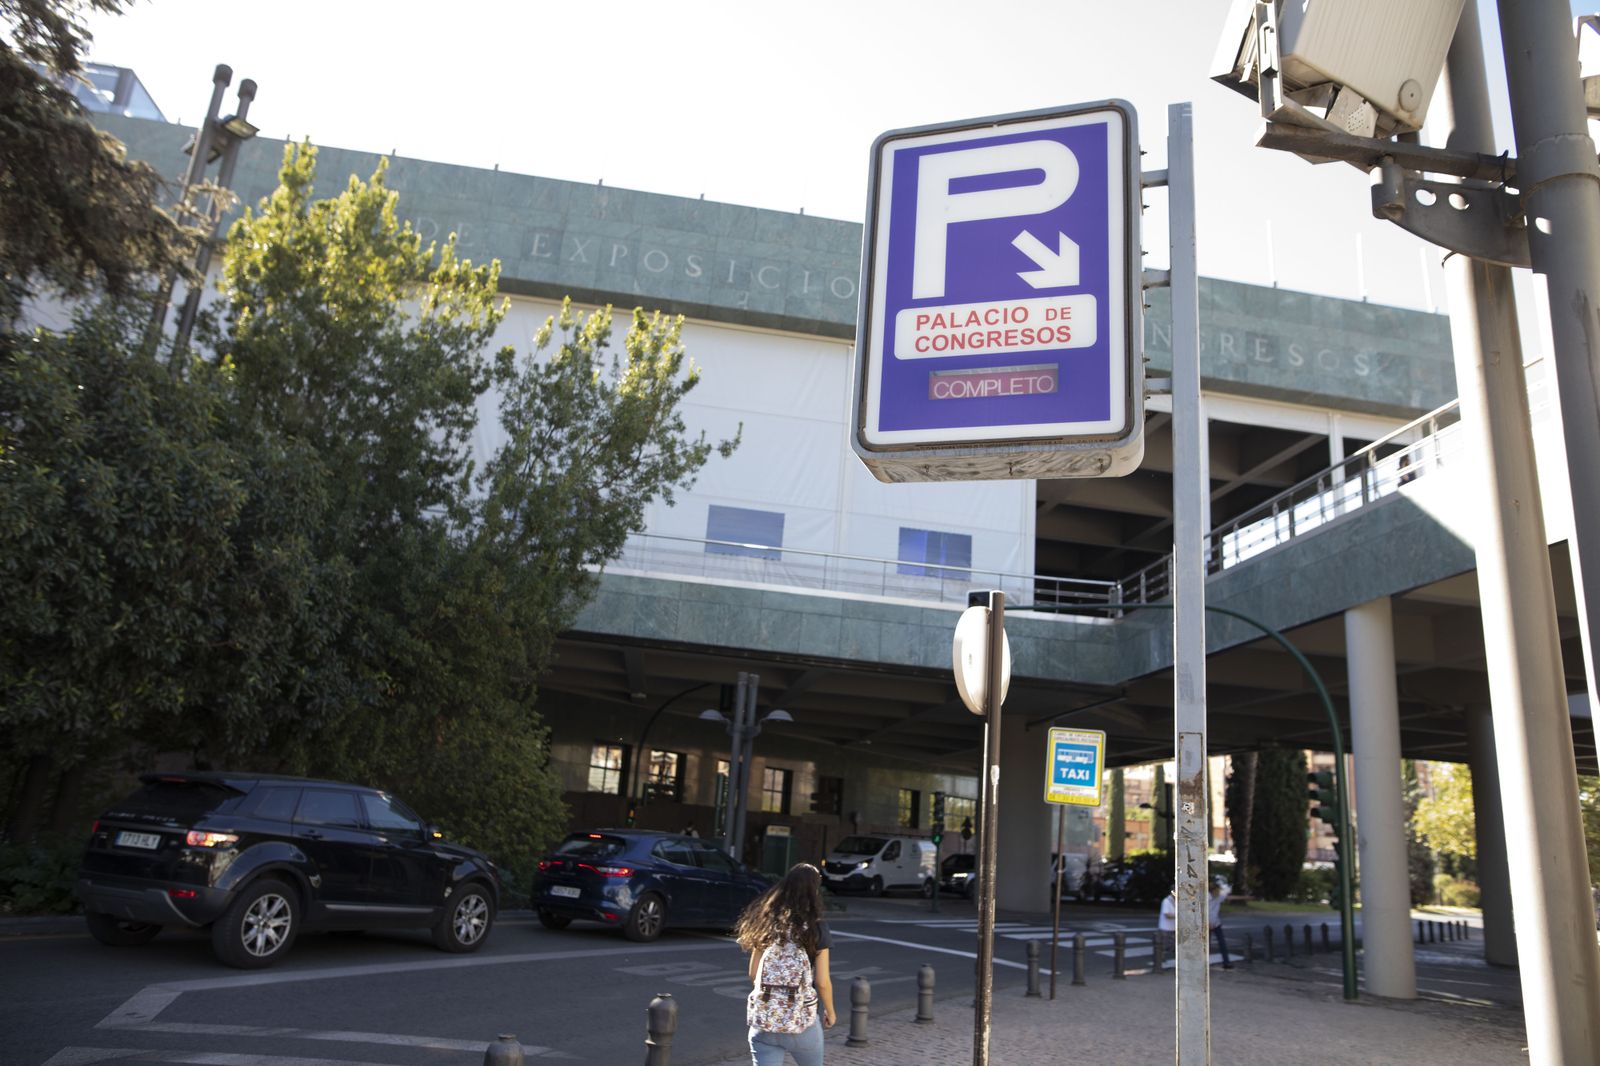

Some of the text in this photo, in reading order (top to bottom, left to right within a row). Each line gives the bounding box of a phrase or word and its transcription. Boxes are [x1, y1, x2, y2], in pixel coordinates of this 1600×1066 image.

[912, 139, 1080, 300] P
[530, 232, 856, 300] EXPOSICIO
[1151, 321, 1370, 377] NRESOS
[916, 305, 1072, 332] PALACIO DE
[914, 324, 1072, 353] CONGRESOS
[933, 374, 1055, 399] COMPLETO
[1060, 767, 1090, 781] TAXI
